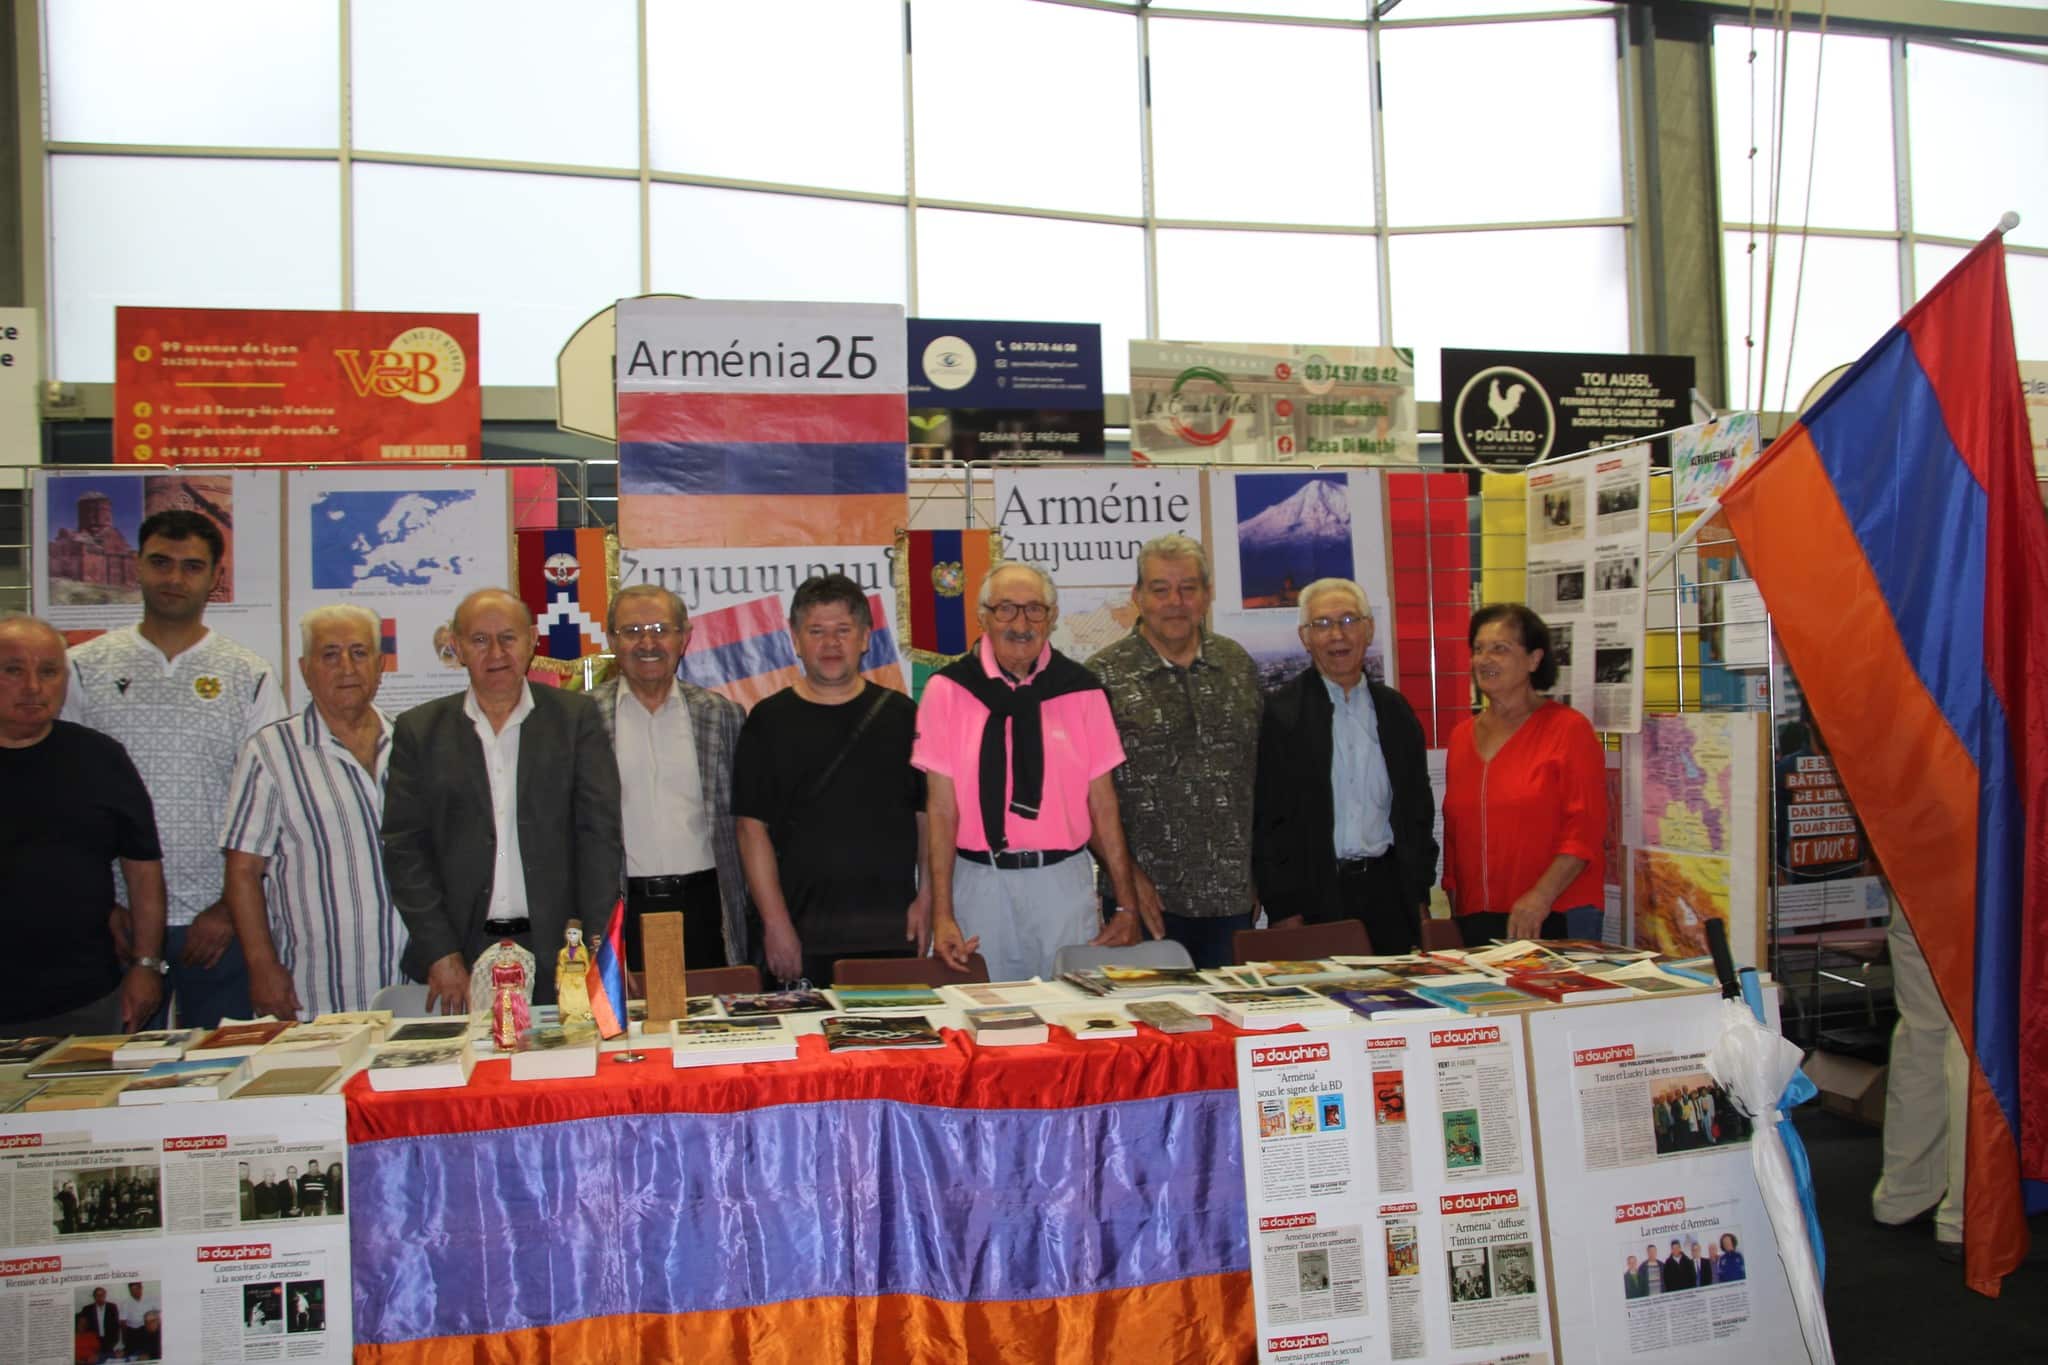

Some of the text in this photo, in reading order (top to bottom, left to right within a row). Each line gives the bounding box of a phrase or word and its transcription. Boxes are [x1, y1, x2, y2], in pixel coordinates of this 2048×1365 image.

[161, 341, 298, 356] 99 avenue de Lyon
[1581, 372, 1608, 387] TOI
[174, 404, 201, 415] and
[1020, 432, 1033, 442] SE
[1475, 429, 1536, 443] POULETO
[223, 447, 241, 458] 77
[1000, 481, 1190, 526] Arménie
[1791, 806, 1826, 819] DANS
[1793, 842, 1809, 865] ET
[1813, 838, 1845, 862] VOUS
[1253, 1050, 1265, 1063] le
[1309, 1083, 1319, 1093] de
[1329, 1080, 1343, 1091] BD
[1442, 1197, 1453, 1210] le
[1497, 1217, 1526, 1229] diffuse
